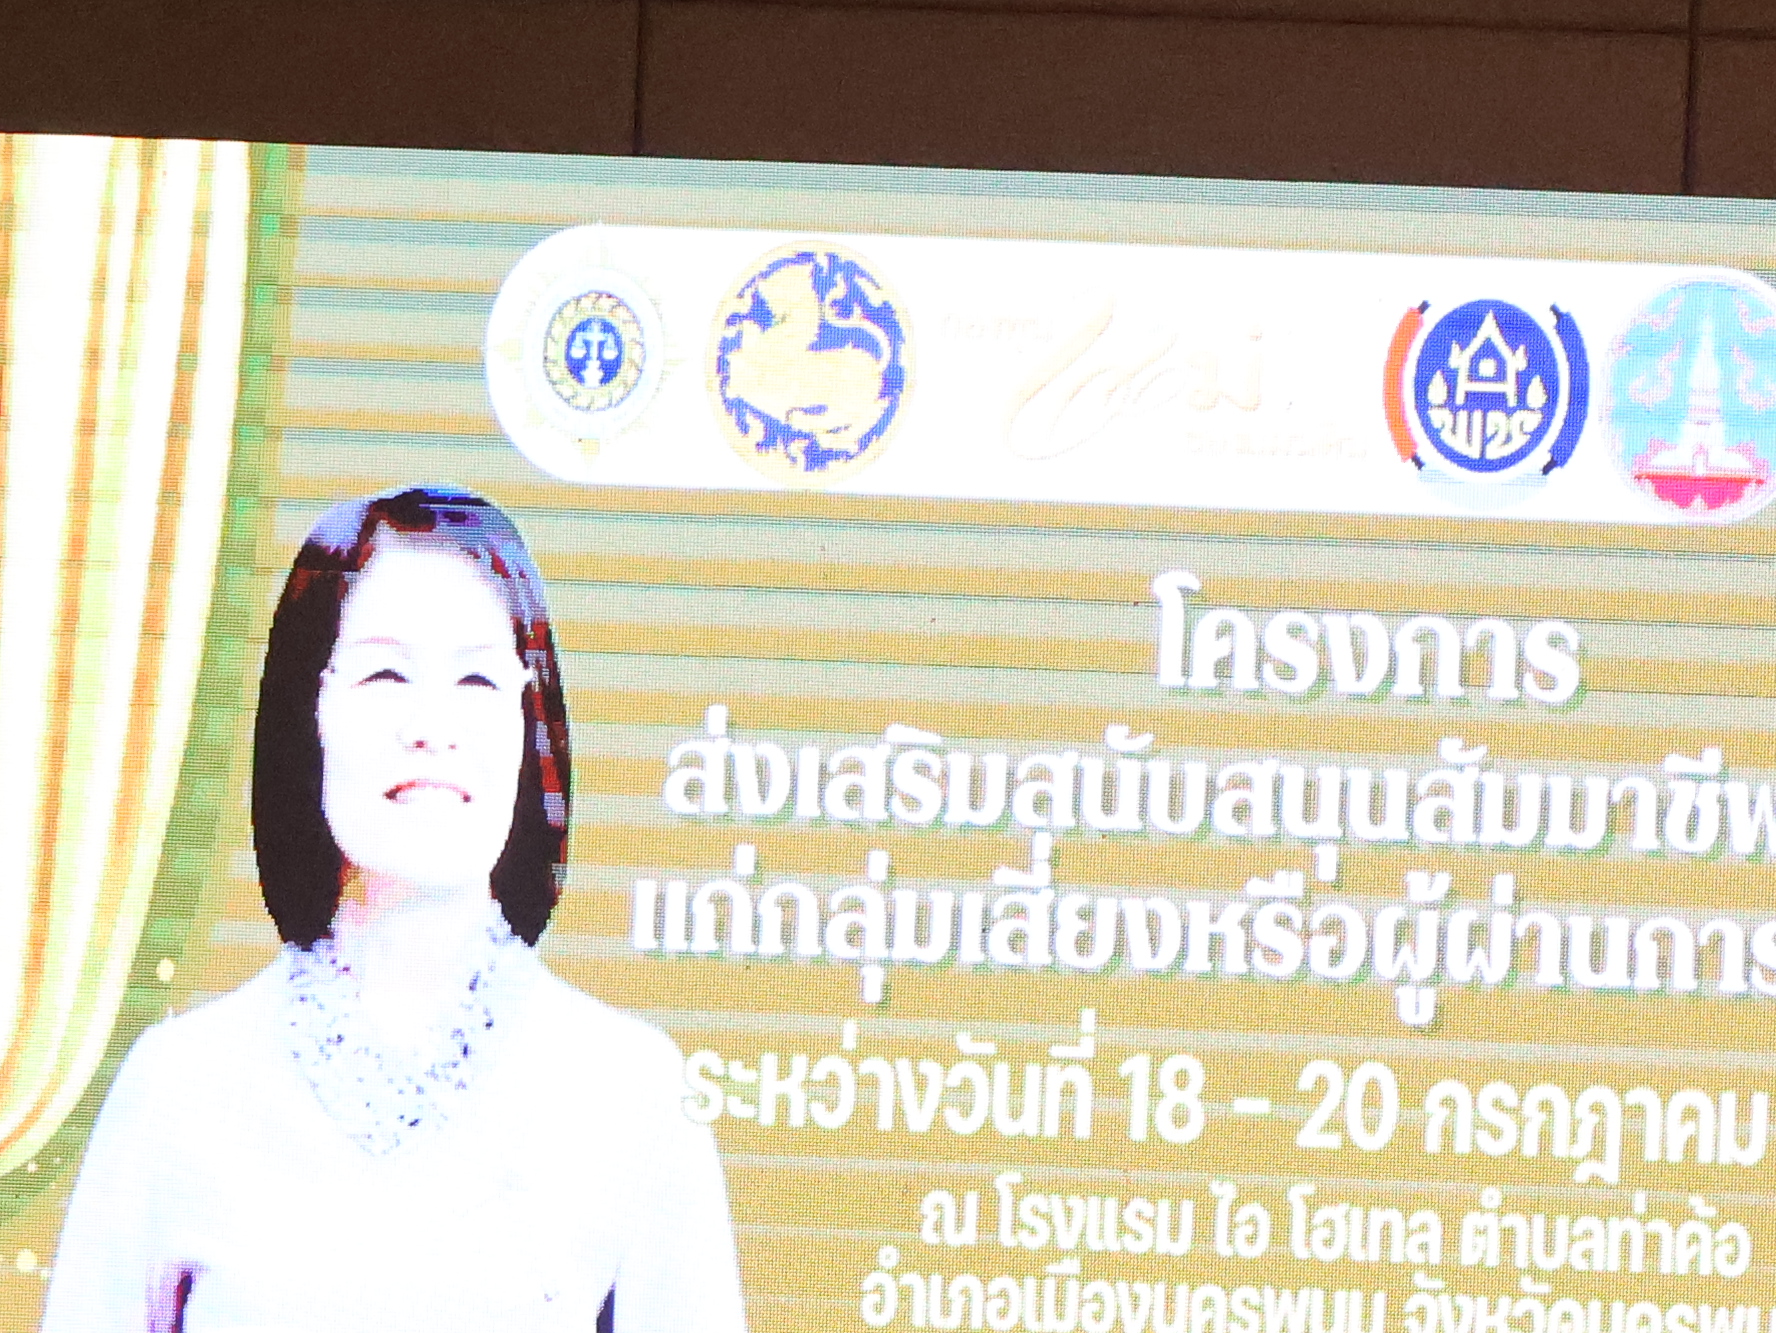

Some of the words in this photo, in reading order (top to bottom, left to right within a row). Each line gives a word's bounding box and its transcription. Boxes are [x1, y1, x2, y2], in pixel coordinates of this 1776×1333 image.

[1153, 565, 1583, 706] โครงการ
[683, 1007, 1095, 1140] ระหว่างวันที่
[1121, 1053, 1207, 1144] 18
[1231, 1096, 1272, 1116] -
[1295, 1060, 1400, 1152] 20
[1424, 1079, 1770, 1184] กรกฎาคม
[921, 1188, 979, 1246] ณ
[993, 1170, 1196, 1257] โรงแรม
[1209, 1176, 1271, 1259] ไอ
[1286, 1182, 1442, 1264] โฮเทล
[1459, 1186, 1752, 1278] ตำบลท่าค้อ
